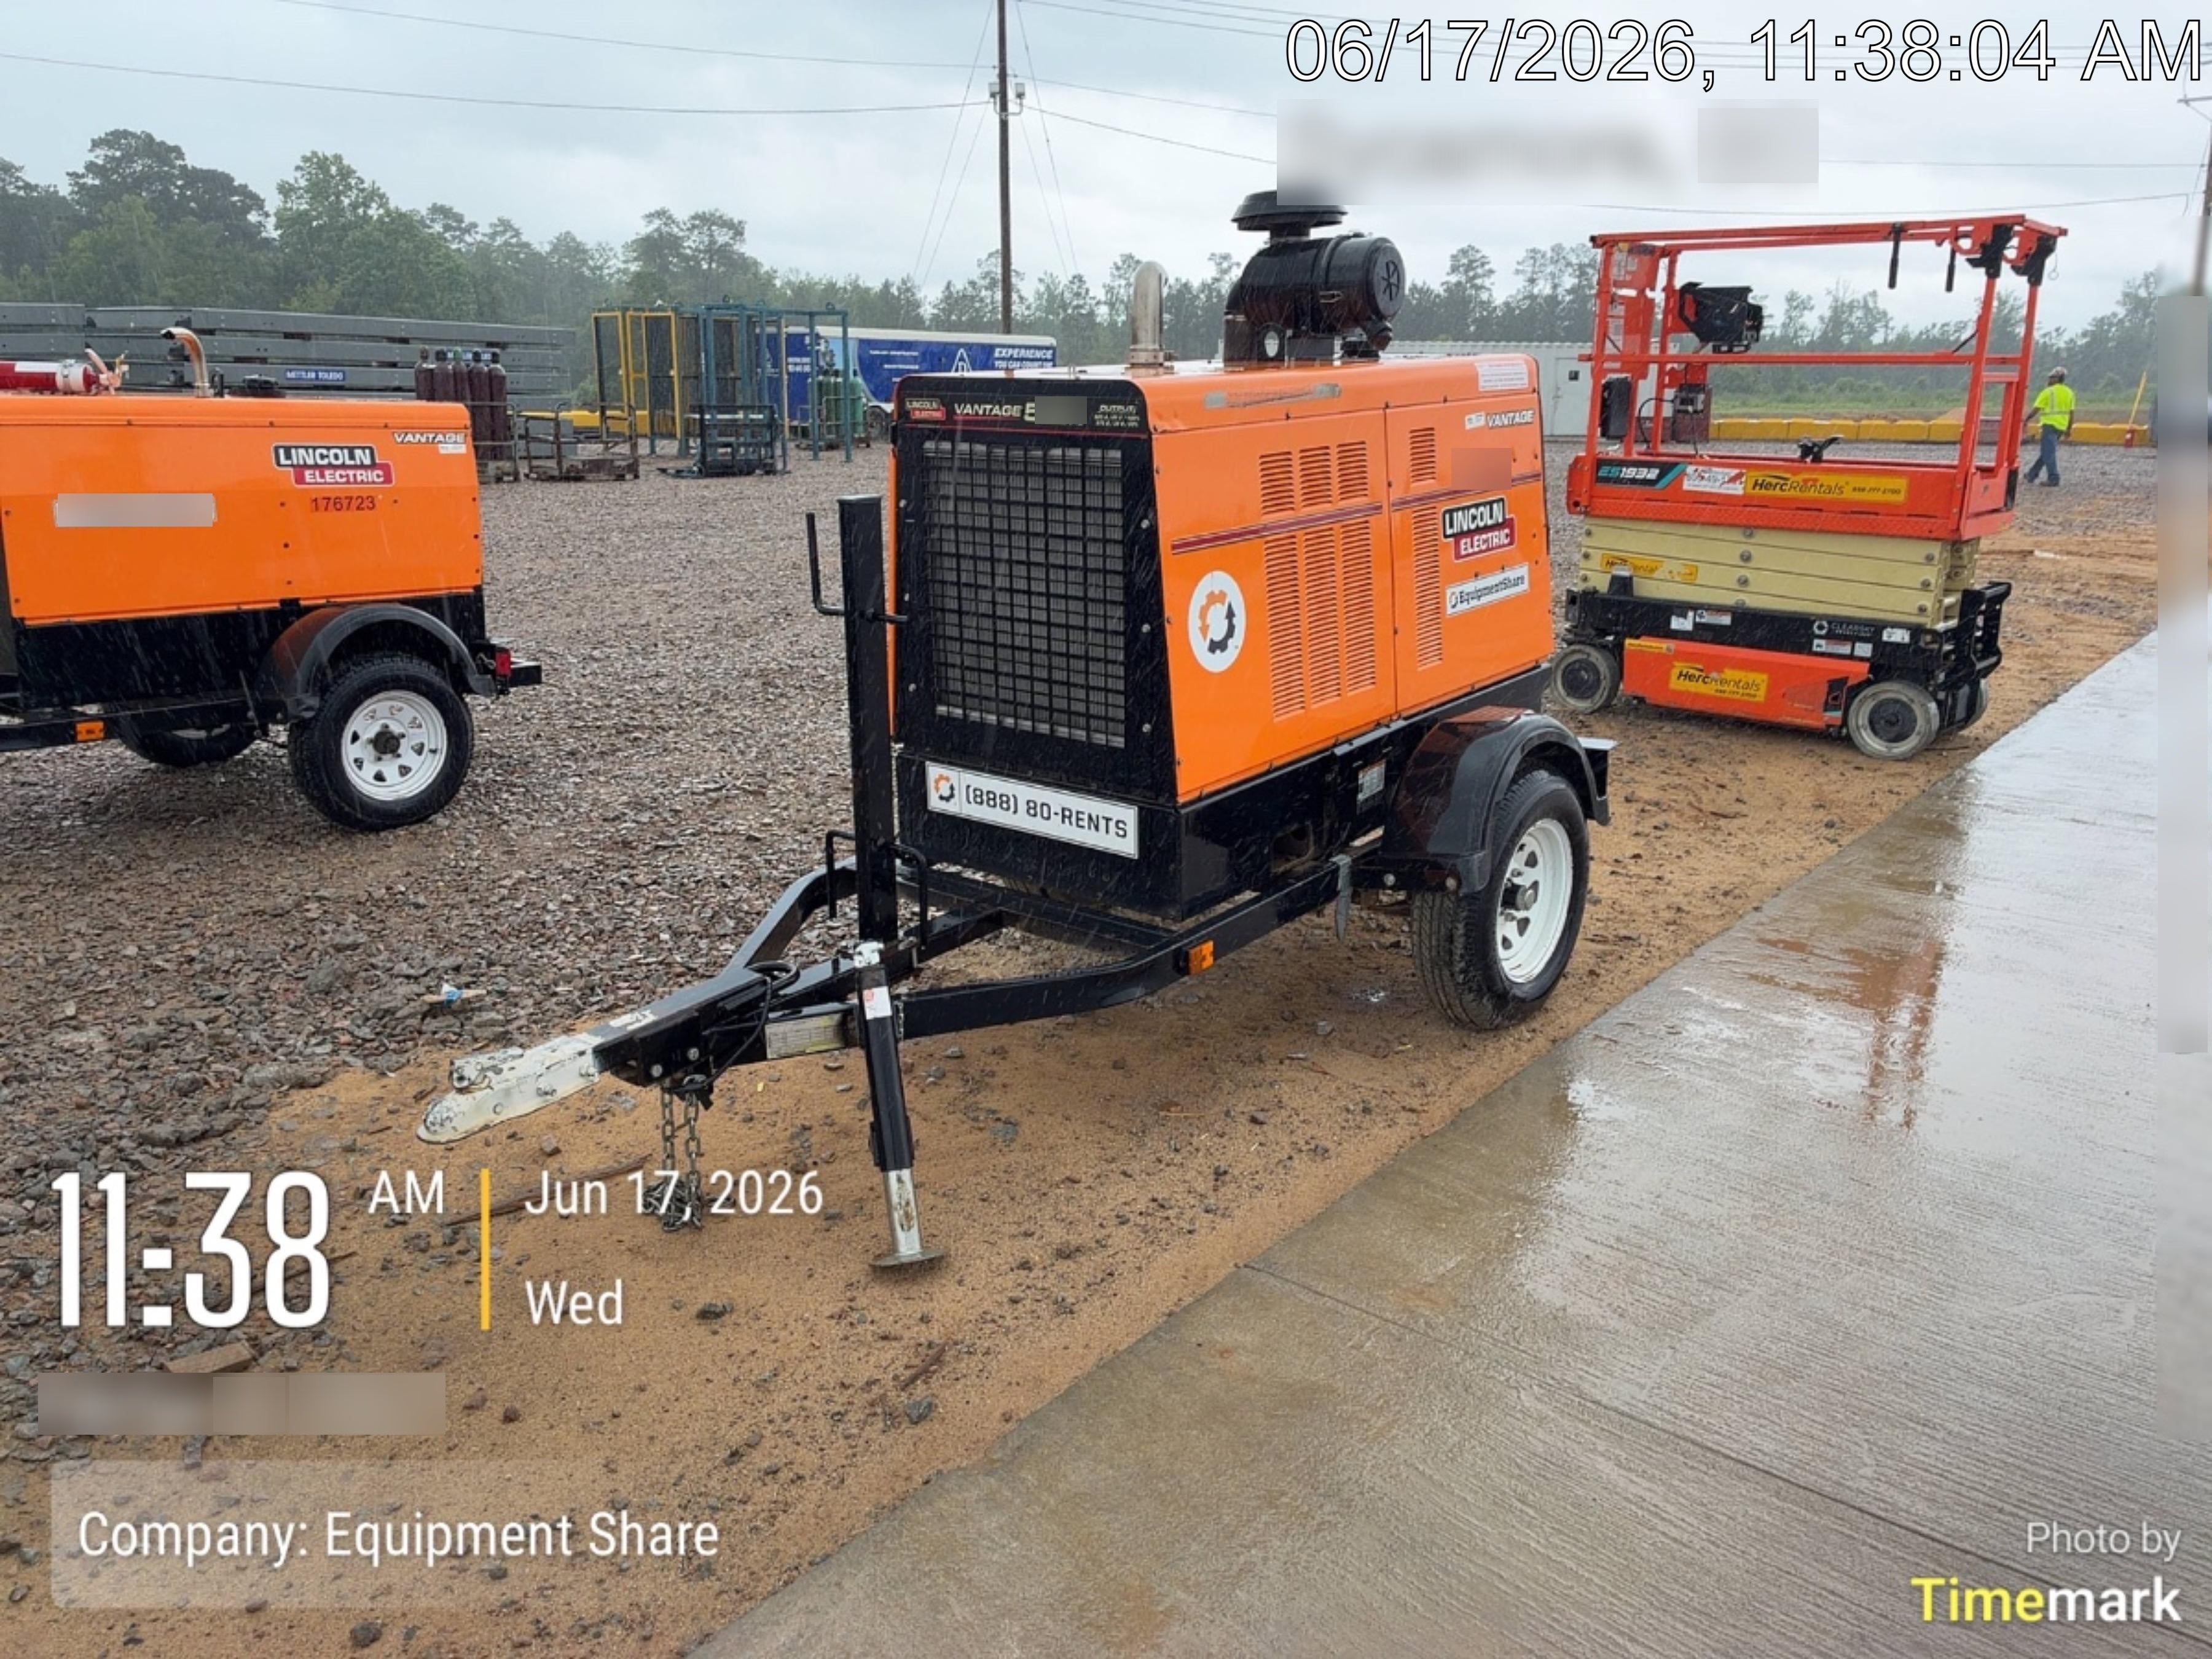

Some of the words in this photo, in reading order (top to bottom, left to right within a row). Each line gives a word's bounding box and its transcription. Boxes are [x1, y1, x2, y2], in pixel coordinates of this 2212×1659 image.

[995, 348, 1053, 360] EXPERIENCE
[955, 403, 1023, 418] VANTAGE
[1487, 410, 1534, 428] VANTAGE
[394, 432, 466, 444] VANTAGE
[278, 448, 371, 465] LINCOLN
[304, 469, 384, 483] ELECTRIC
[1598, 466, 1660, 480] ES1932
[311, 495, 376, 511] 176723
[1445, 501, 1504, 535] LINCOLN
[1460, 528, 1511, 556] ELECTRIC
[1459, 574, 1525, 605] EquipmentShare
[965, 784, 1019, 815] (888)
[1026, 800, 1128, 838] 80-RENTS
